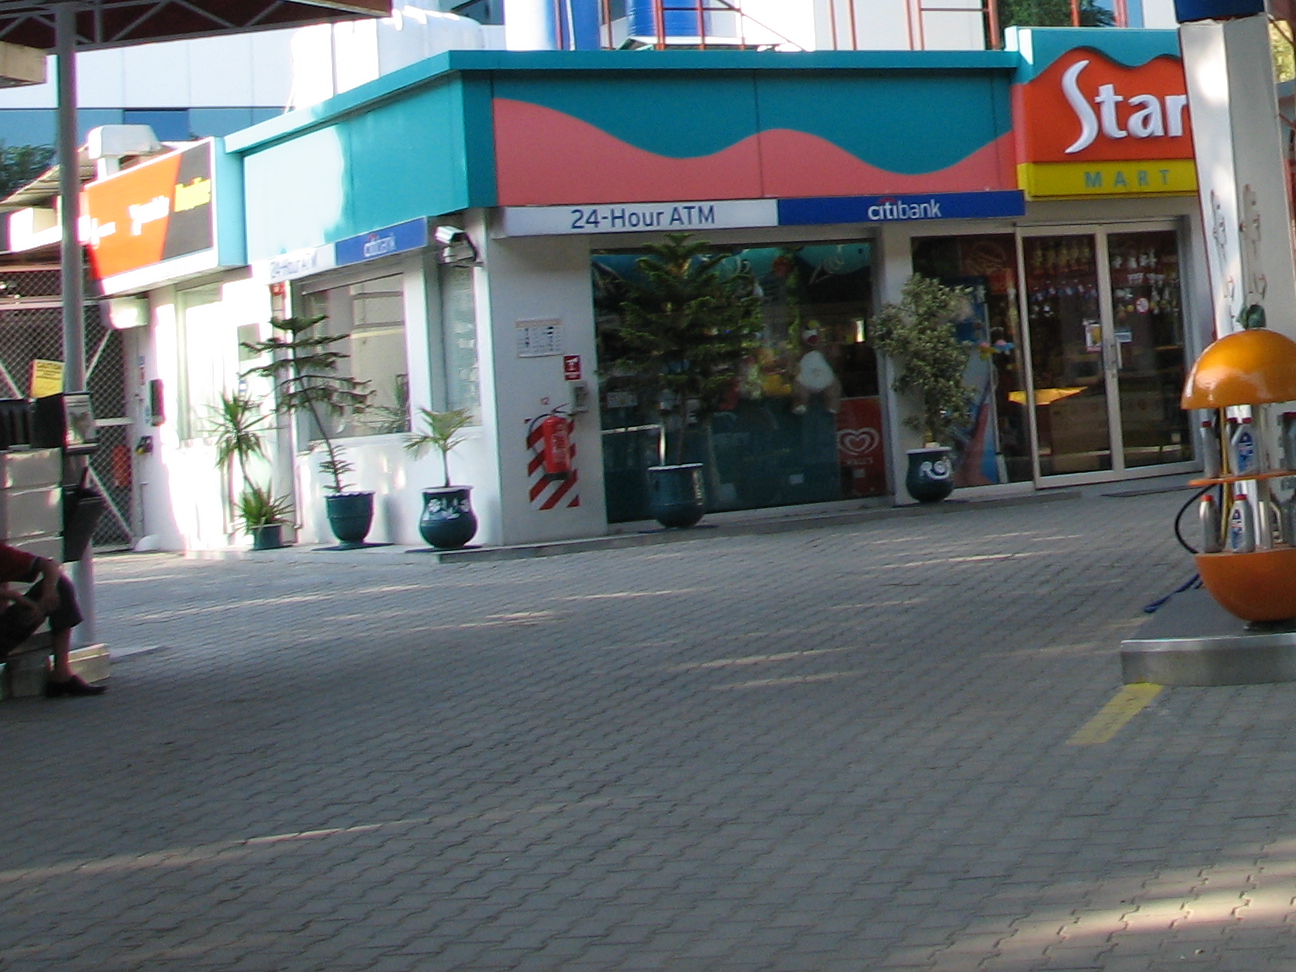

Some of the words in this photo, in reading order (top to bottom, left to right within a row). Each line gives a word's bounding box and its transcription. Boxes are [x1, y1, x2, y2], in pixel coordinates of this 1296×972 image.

[1061, 59, 1188, 155] Star
[1084, 169, 1170, 188] MART
[571, 207, 664, 229] 24-Hour
[669, 205, 716, 226] ATM
[867, 198, 942, 220] citibank
